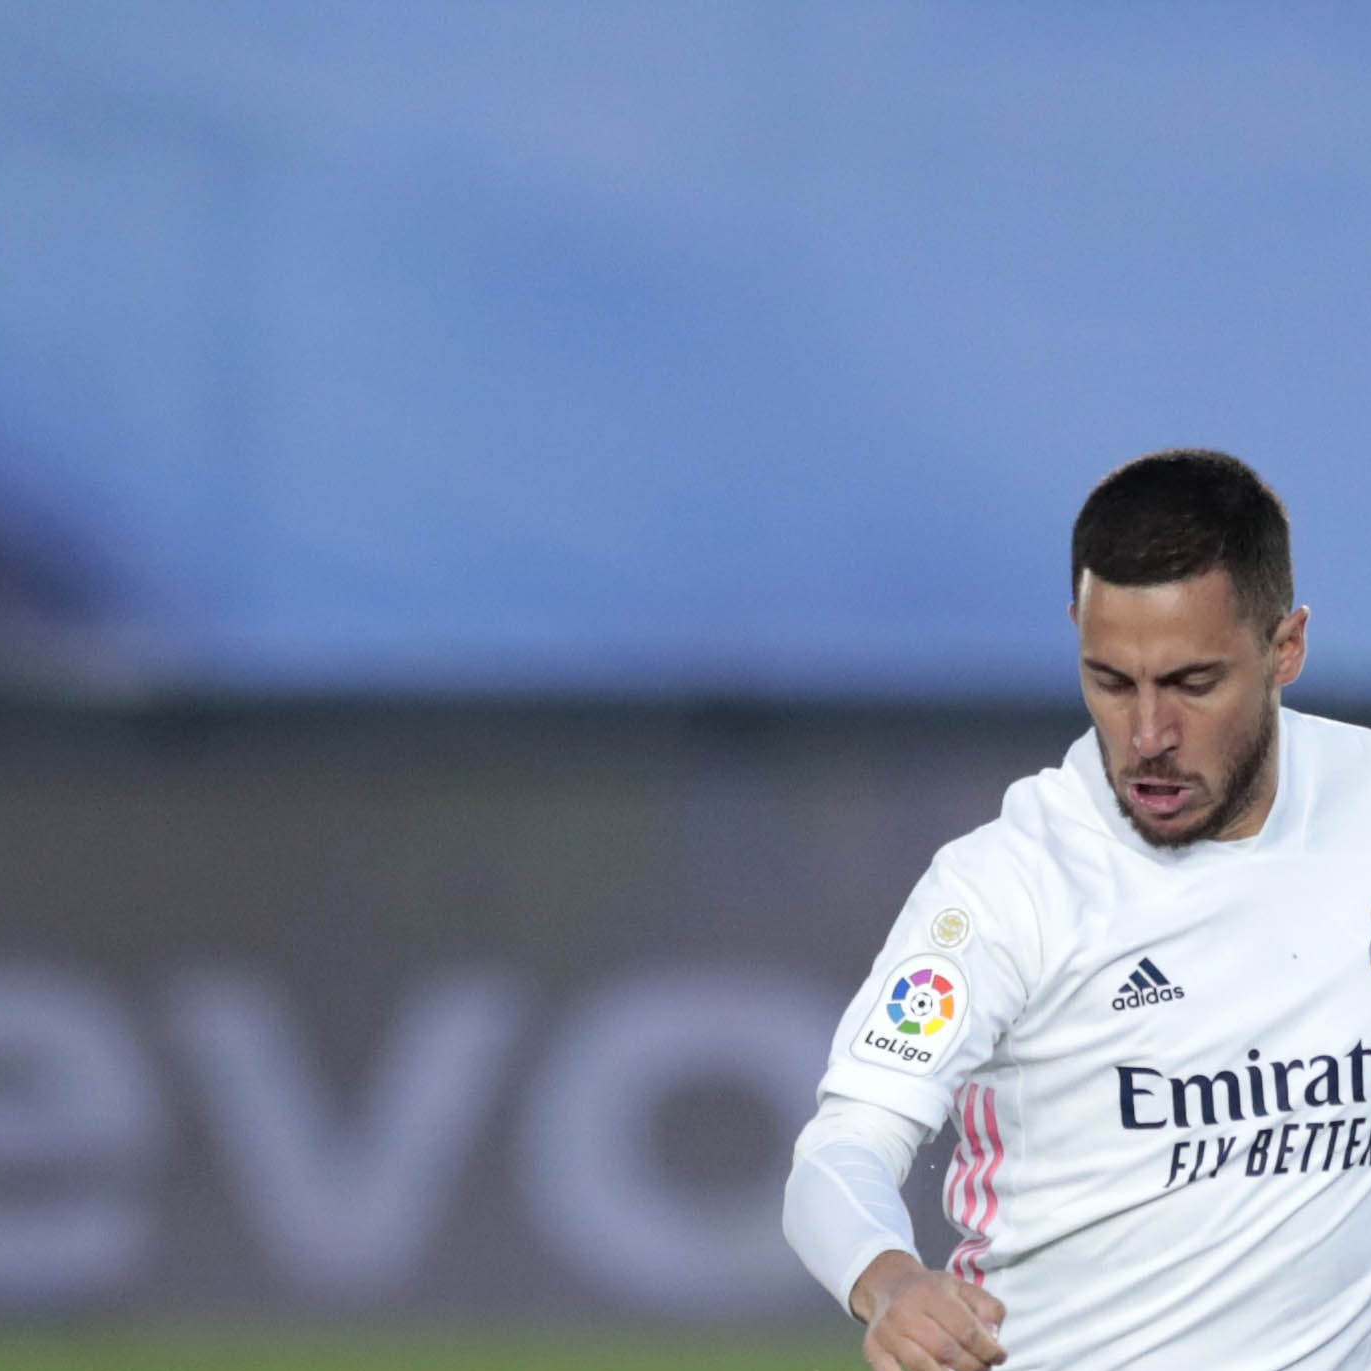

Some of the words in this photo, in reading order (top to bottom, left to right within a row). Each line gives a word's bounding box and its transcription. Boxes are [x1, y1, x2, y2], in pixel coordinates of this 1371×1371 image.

[1112, 985, 1186, 1012] adidas
[864, 1030, 933, 1064] LaLiga
[1163, 1136, 1237, 1188] FLY
